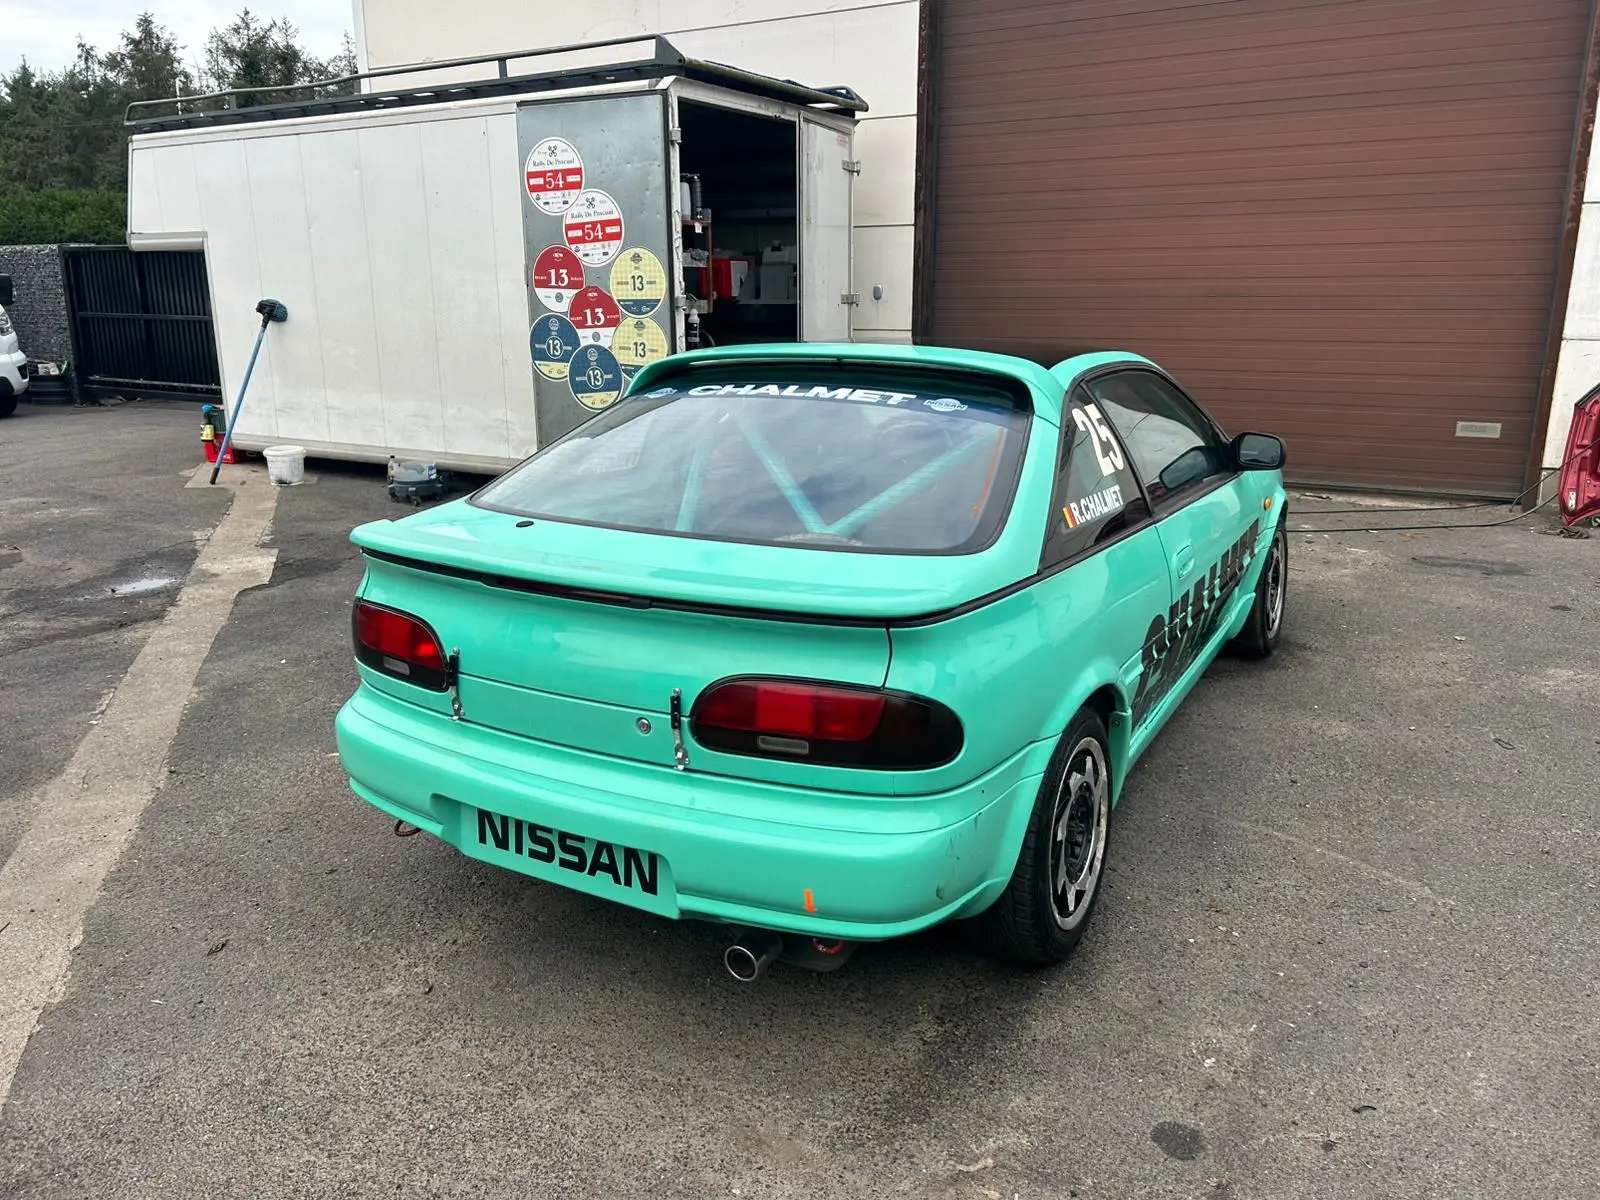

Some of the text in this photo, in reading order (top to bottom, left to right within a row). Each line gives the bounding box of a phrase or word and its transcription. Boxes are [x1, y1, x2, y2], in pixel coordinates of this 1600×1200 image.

[545, 171, 564, 189] 54
[584, 223, 603, 241] 54
[547, 268, 569, 287] 13
[630, 275, 645, 291] 13
[583, 307, 605, 326] 13
[547, 339, 561, 356] 13
[633, 341, 646, 358] 13
[588, 369, 602, 386] 13
[688, 384, 917, 405] CHALMET
[924, 399, 969, 412] NISSAN
[1071, 403, 1124, 477] 25
[1069, 484, 1124, 525] R.CHALMET
[476, 807, 658, 897] NISSAN
